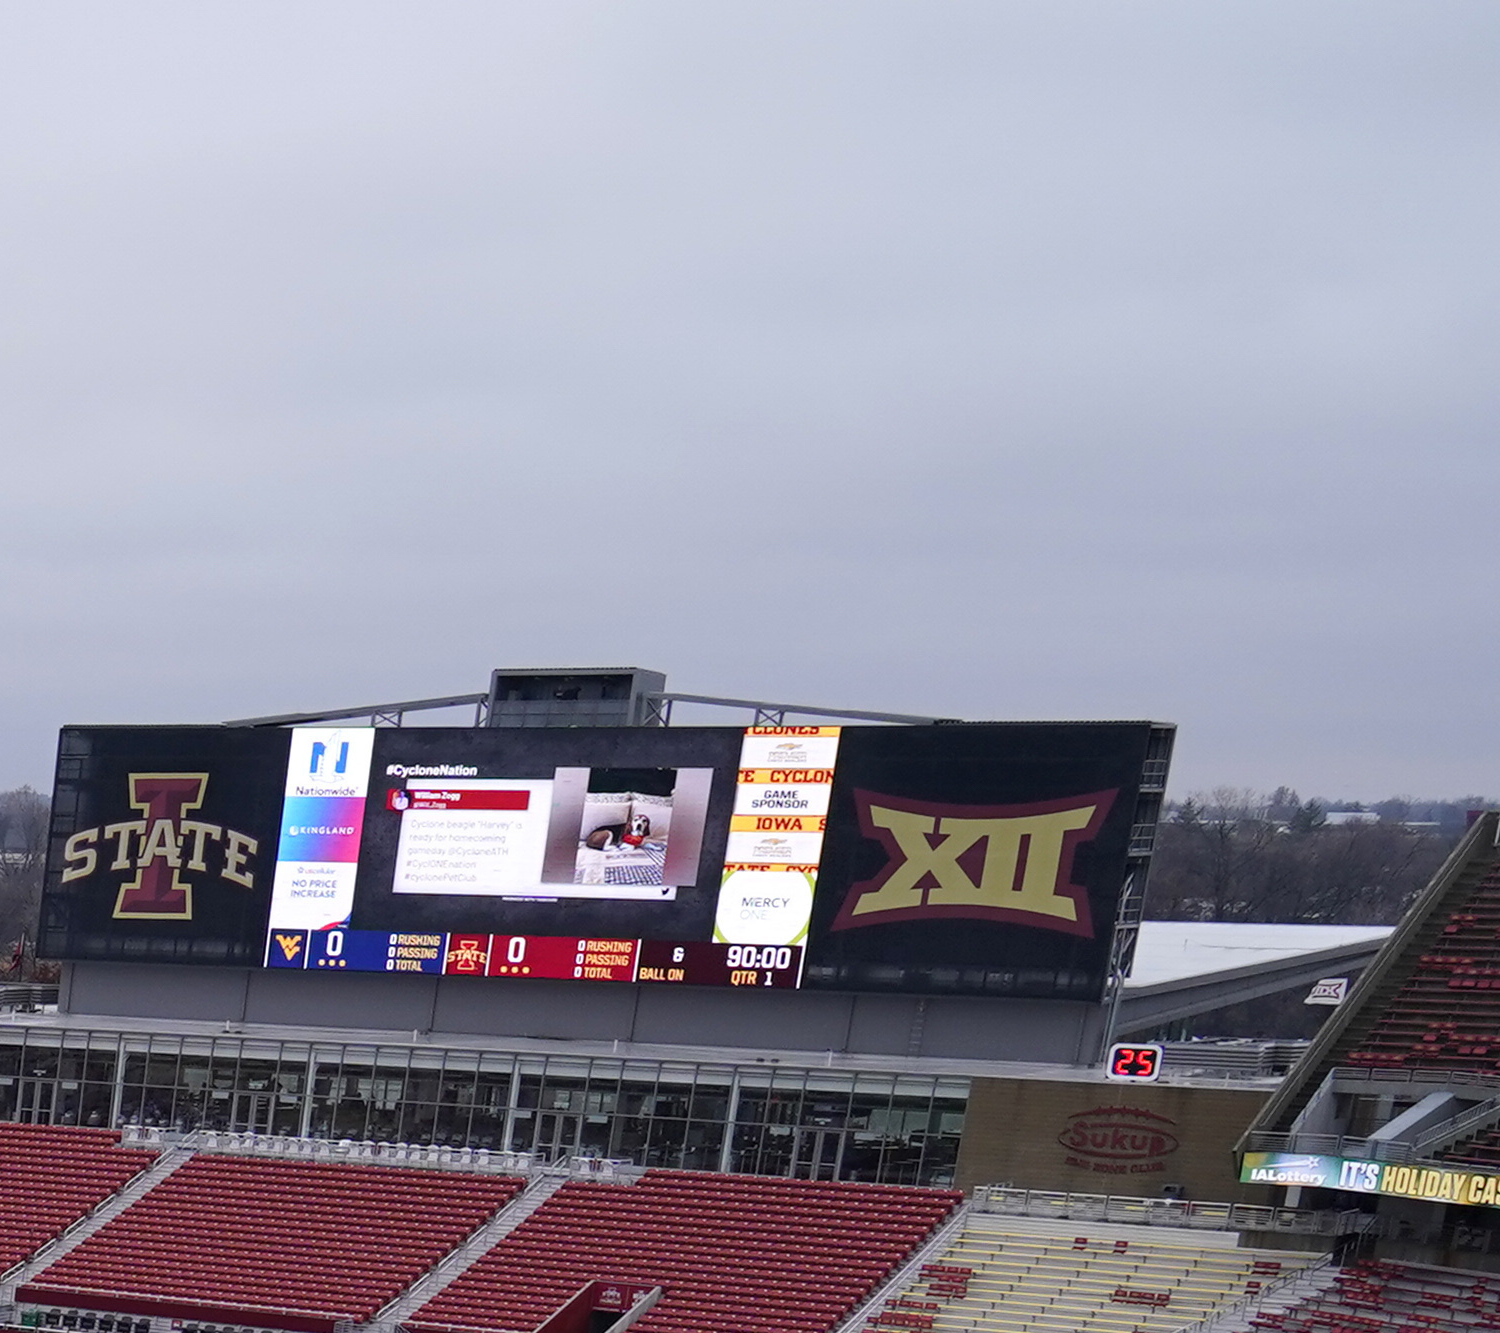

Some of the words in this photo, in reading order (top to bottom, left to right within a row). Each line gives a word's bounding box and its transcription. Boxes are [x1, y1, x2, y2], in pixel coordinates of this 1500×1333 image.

[386, 764, 478, 778] #CycloneNation
[295, 785, 357, 797] Nationwide
[763, 790, 799, 799] GAME
[751, 799, 809, 809] SPONSOR
[300, 825, 355, 836] KINGLAND
[756, 817, 802, 831] IOWA
[62, 819, 260, 888] STATE
[852, 804, 1097, 922] XII
[291, 879, 308, 889] NO
[310, 879, 338, 890] PRICE
[290, 889, 336, 899] INCREASE
[741, 897, 790, 908] MERCY
[327, 930, 343, 957] 0
[397, 934, 442, 947] RUSHING
[507, 936, 526, 963] 0
[586, 941, 632, 954] RUSHING
[396, 946, 438, 959] PASSING
[584, 953, 629, 966] PASSING
[726, 945, 792, 970] 90:00
[395, 959, 423, 972] TOTAL
[583, 966, 612, 979] TOTAL
[639, 967, 665, 981] BALL
[667, 968, 684, 982] ON
[730, 969, 757, 986] QTR
[764, 971, 773, 987] 1
[1114, 1049, 1154, 1075] 25
[1068, 1121, 1166, 1157] Sukup
[1251, 1168, 1327, 1186] IALottery
[1339, 1161, 1380, 1190] IT'S
[1381, 1166, 1467, 1201] HOLIDAY
